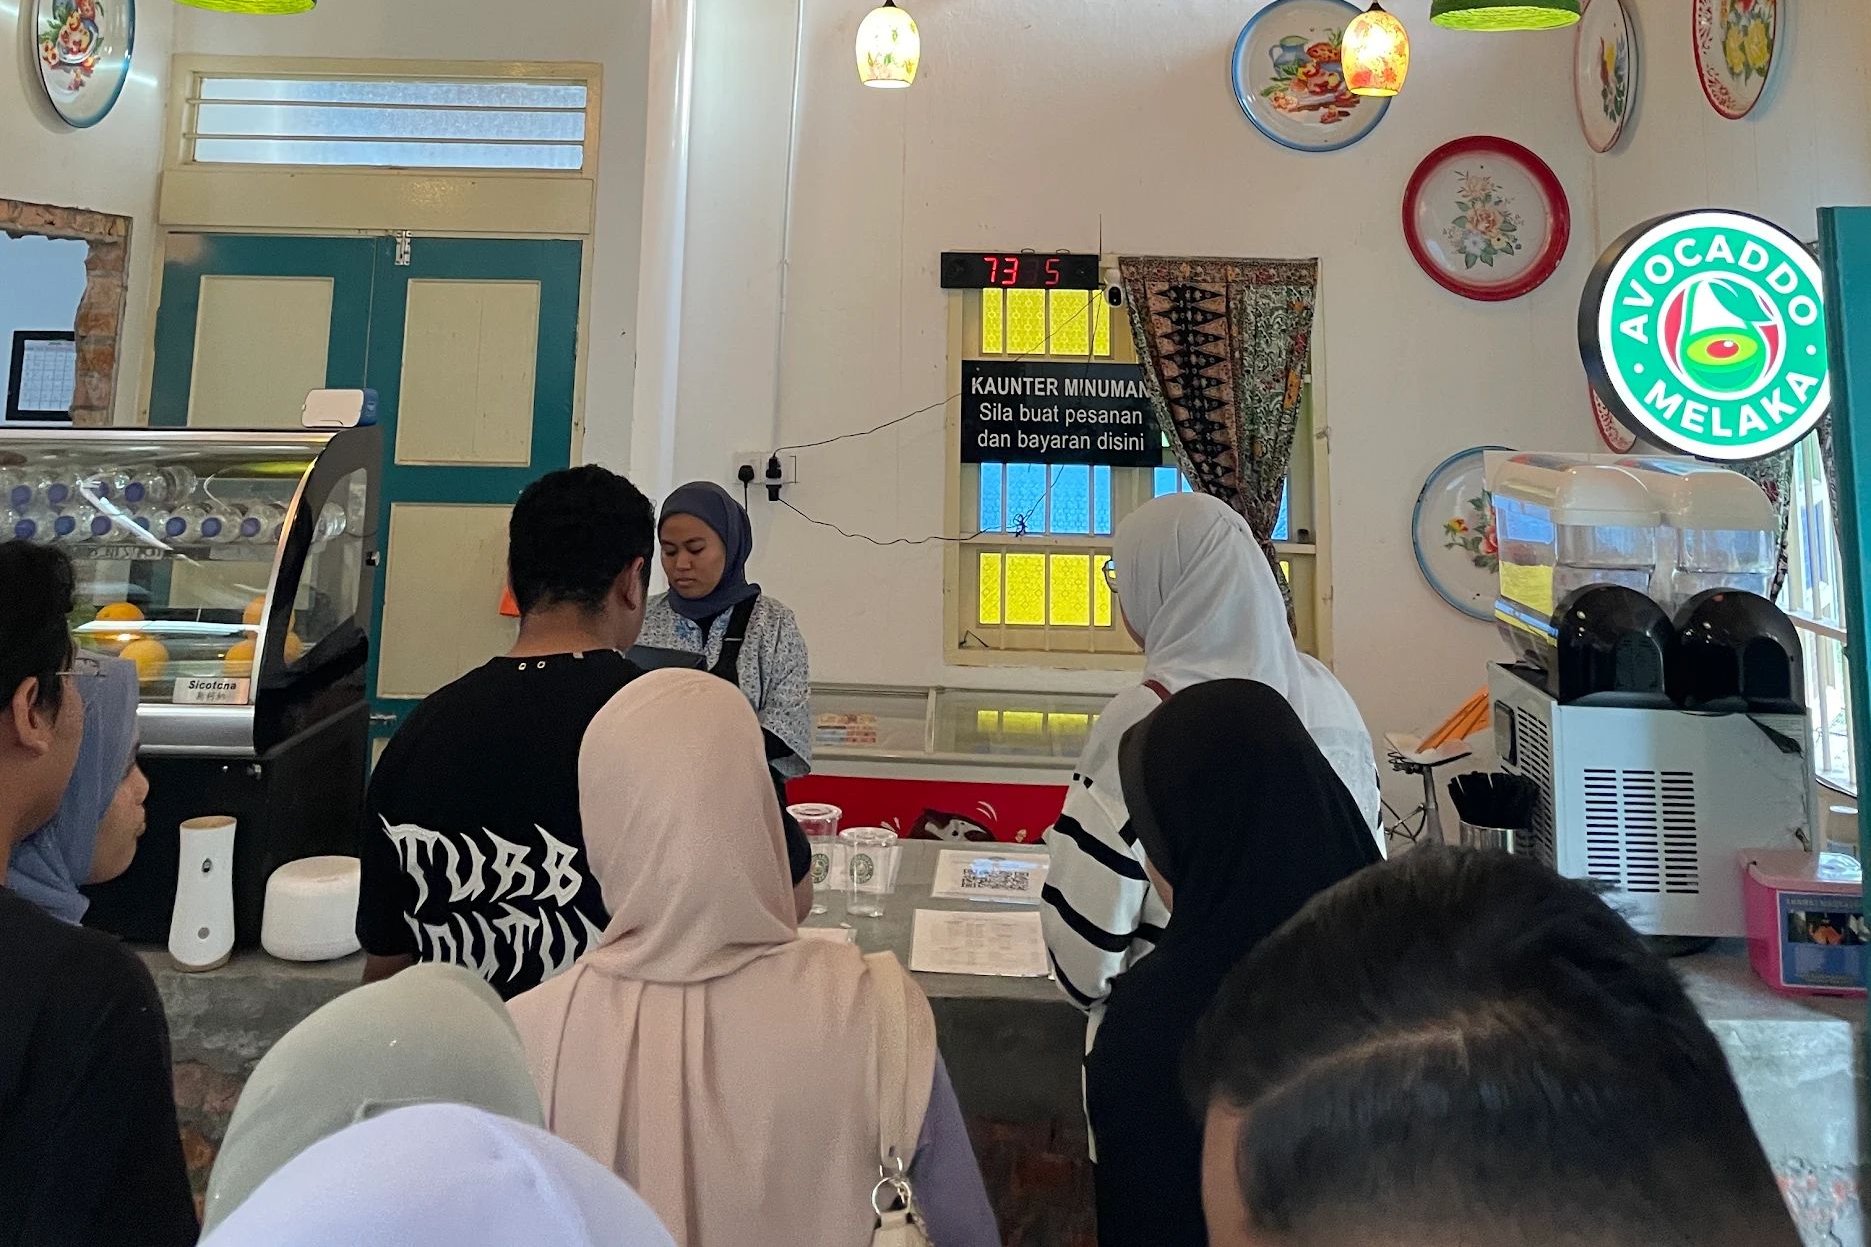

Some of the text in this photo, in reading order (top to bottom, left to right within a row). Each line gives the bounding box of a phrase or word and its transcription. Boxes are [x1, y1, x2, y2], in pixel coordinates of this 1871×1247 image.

[1620, 234, 1818, 344] AVOCADDO
[971, 376, 1151, 398] KAUNTER MINUMAN
[979, 402, 1143, 426] Sila buat pesanan
[1644, 371, 1819, 438] MELAKA
[977, 429, 1145, 453] dan bayaran disini
